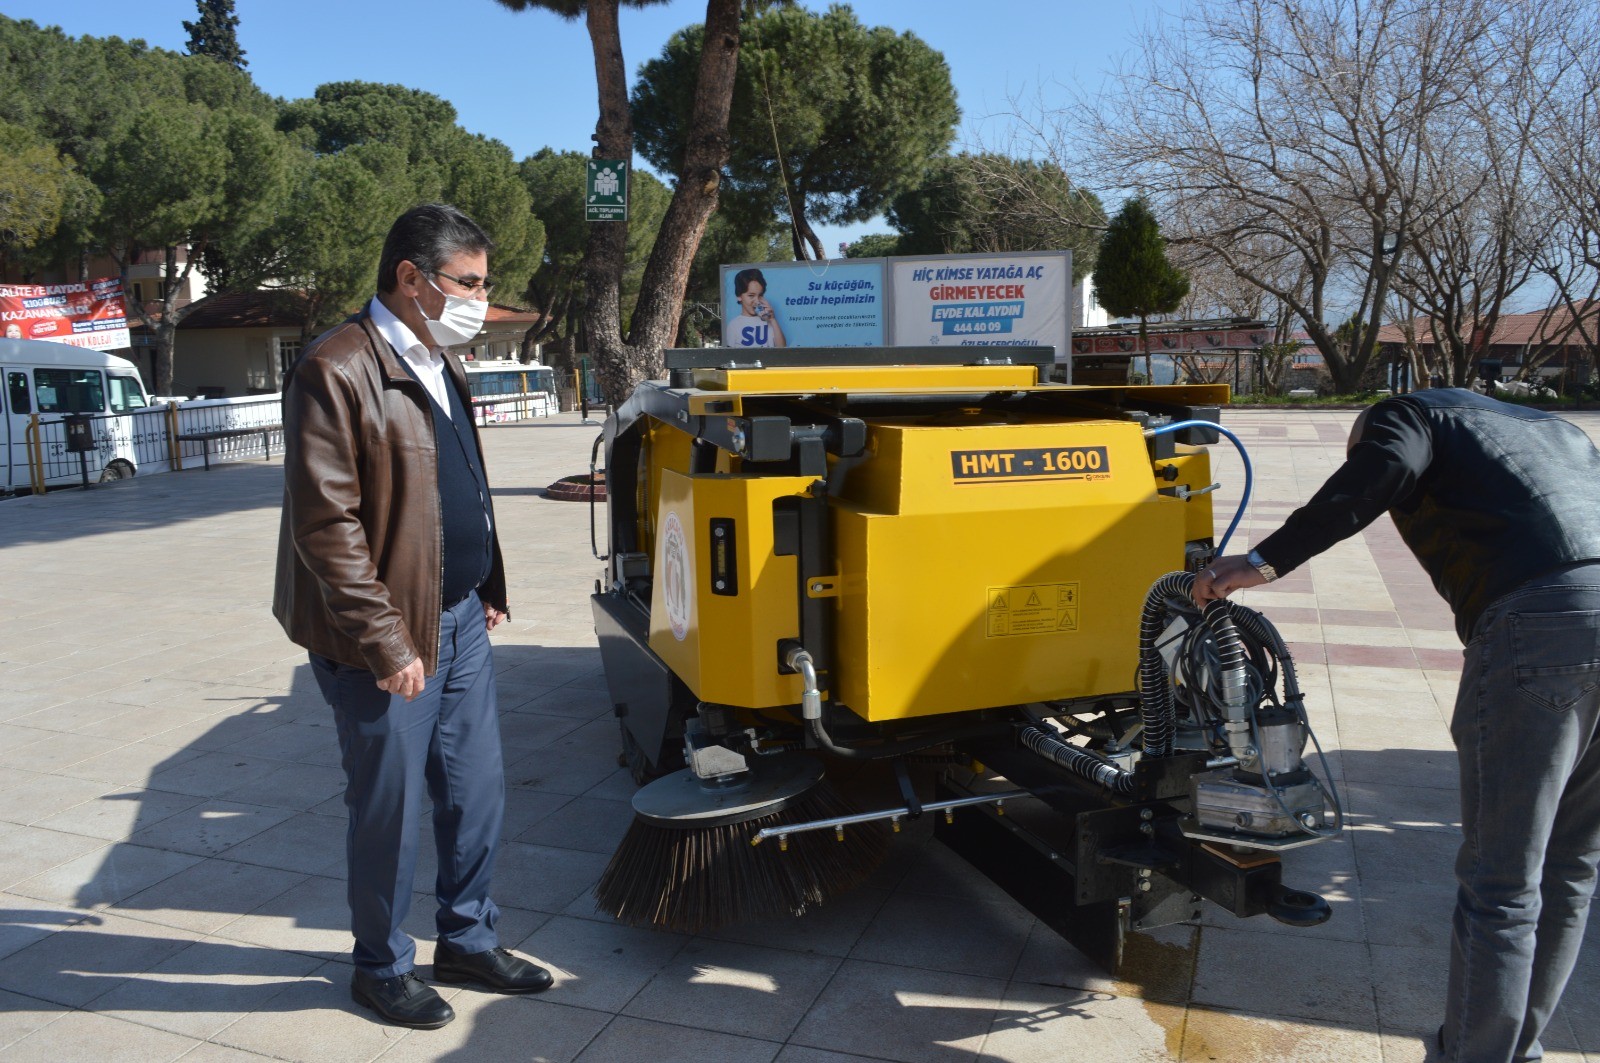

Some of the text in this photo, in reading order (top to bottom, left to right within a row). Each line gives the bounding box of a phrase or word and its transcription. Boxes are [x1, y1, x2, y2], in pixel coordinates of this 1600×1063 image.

[913, 265, 1044, 282] HİÇ KİMSE YATAĞA AÇ
[46, 283, 88, 295] KAYDOL
[808, 280, 875, 292] Su küçüğün,
[929, 284, 1025, 300] GİRMEYECEK
[786, 294, 875, 306] tedbir hepimizin
[934, 305, 1021, 319] EVDE KAL AYDIN
[953, 322, 1001, 332] 444 40 09
[741, 324, 768, 347] SU
[960, 453, 1015, 474] HMT
[1042, 450, 1101, 471] 1600
